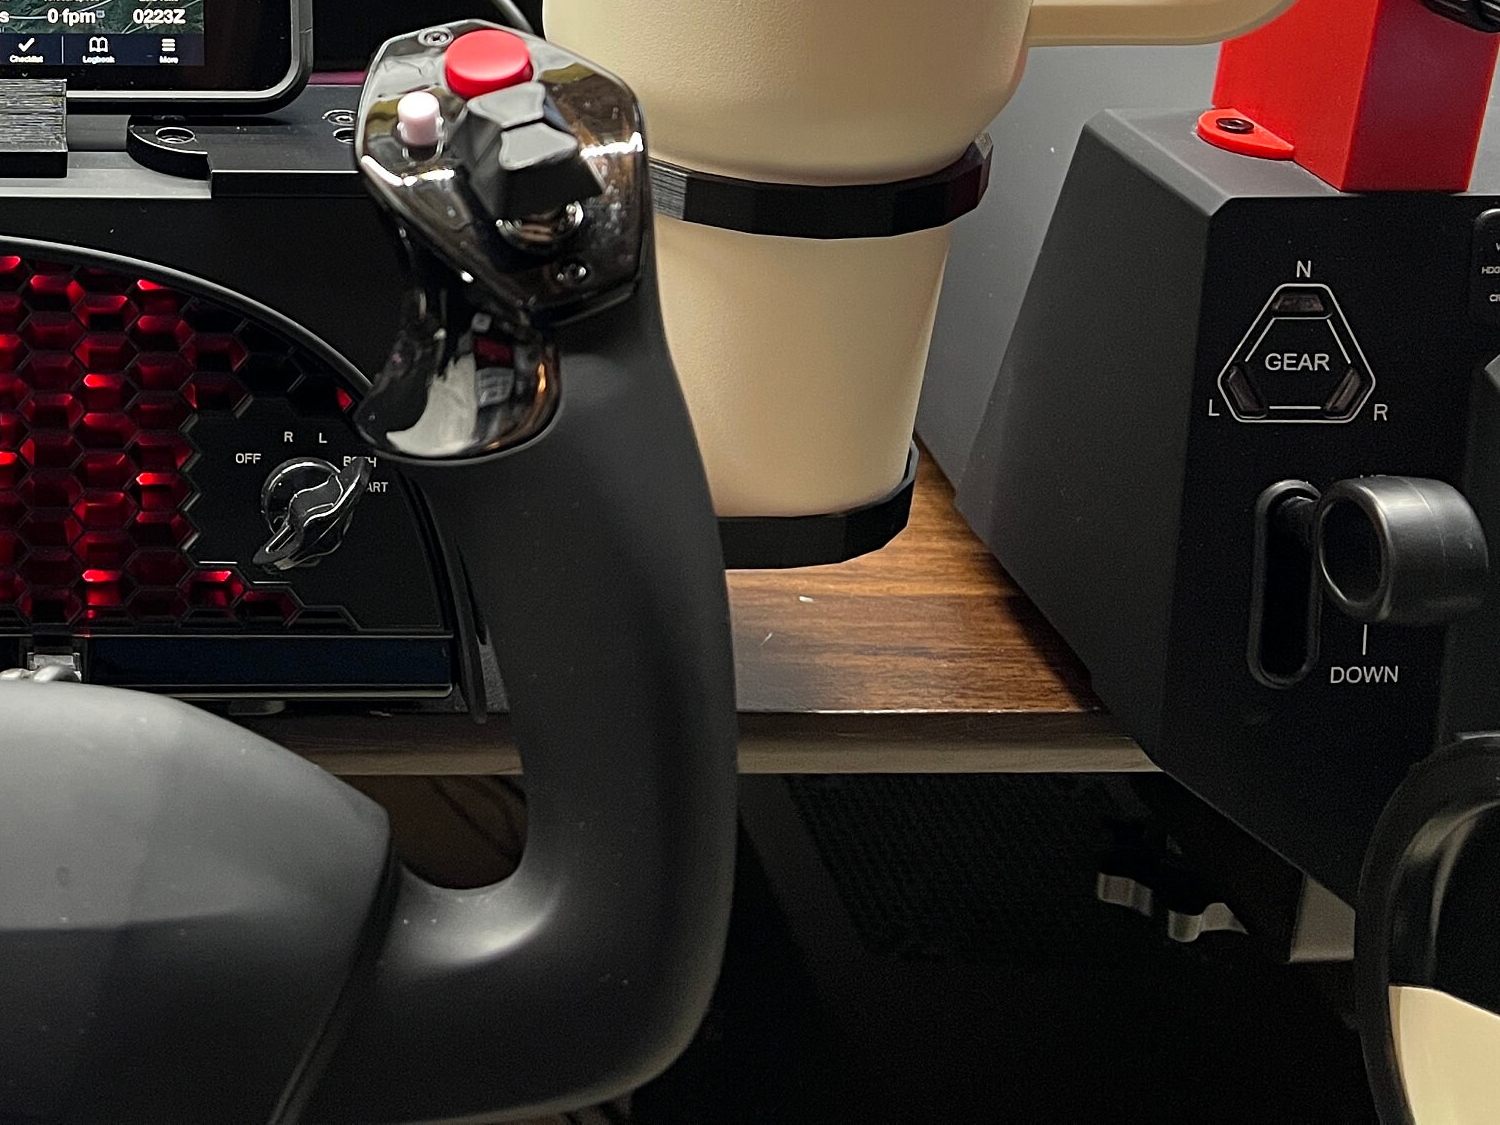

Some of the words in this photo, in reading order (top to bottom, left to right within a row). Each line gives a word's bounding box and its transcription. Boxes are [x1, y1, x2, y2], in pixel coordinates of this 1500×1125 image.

[47, 8, 59, 24] 0
[62, 8, 96, 26] fpm
[132, 8, 187, 25] 0223Z
[82, 56, 115, 65] Logbook
[159, 56, 179, 64] More
[1296, 260, 1311, 278] N
[1264, 353, 1330, 372] GEAR
[1208, 399, 1220, 417] L
[1373, 403, 1388, 421] R
[284, 431, 294, 443] R
[318, 432, 328, 444] L
[235, 453, 262, 465] OFF
[1329, 666, 1399, 684] DOWN
